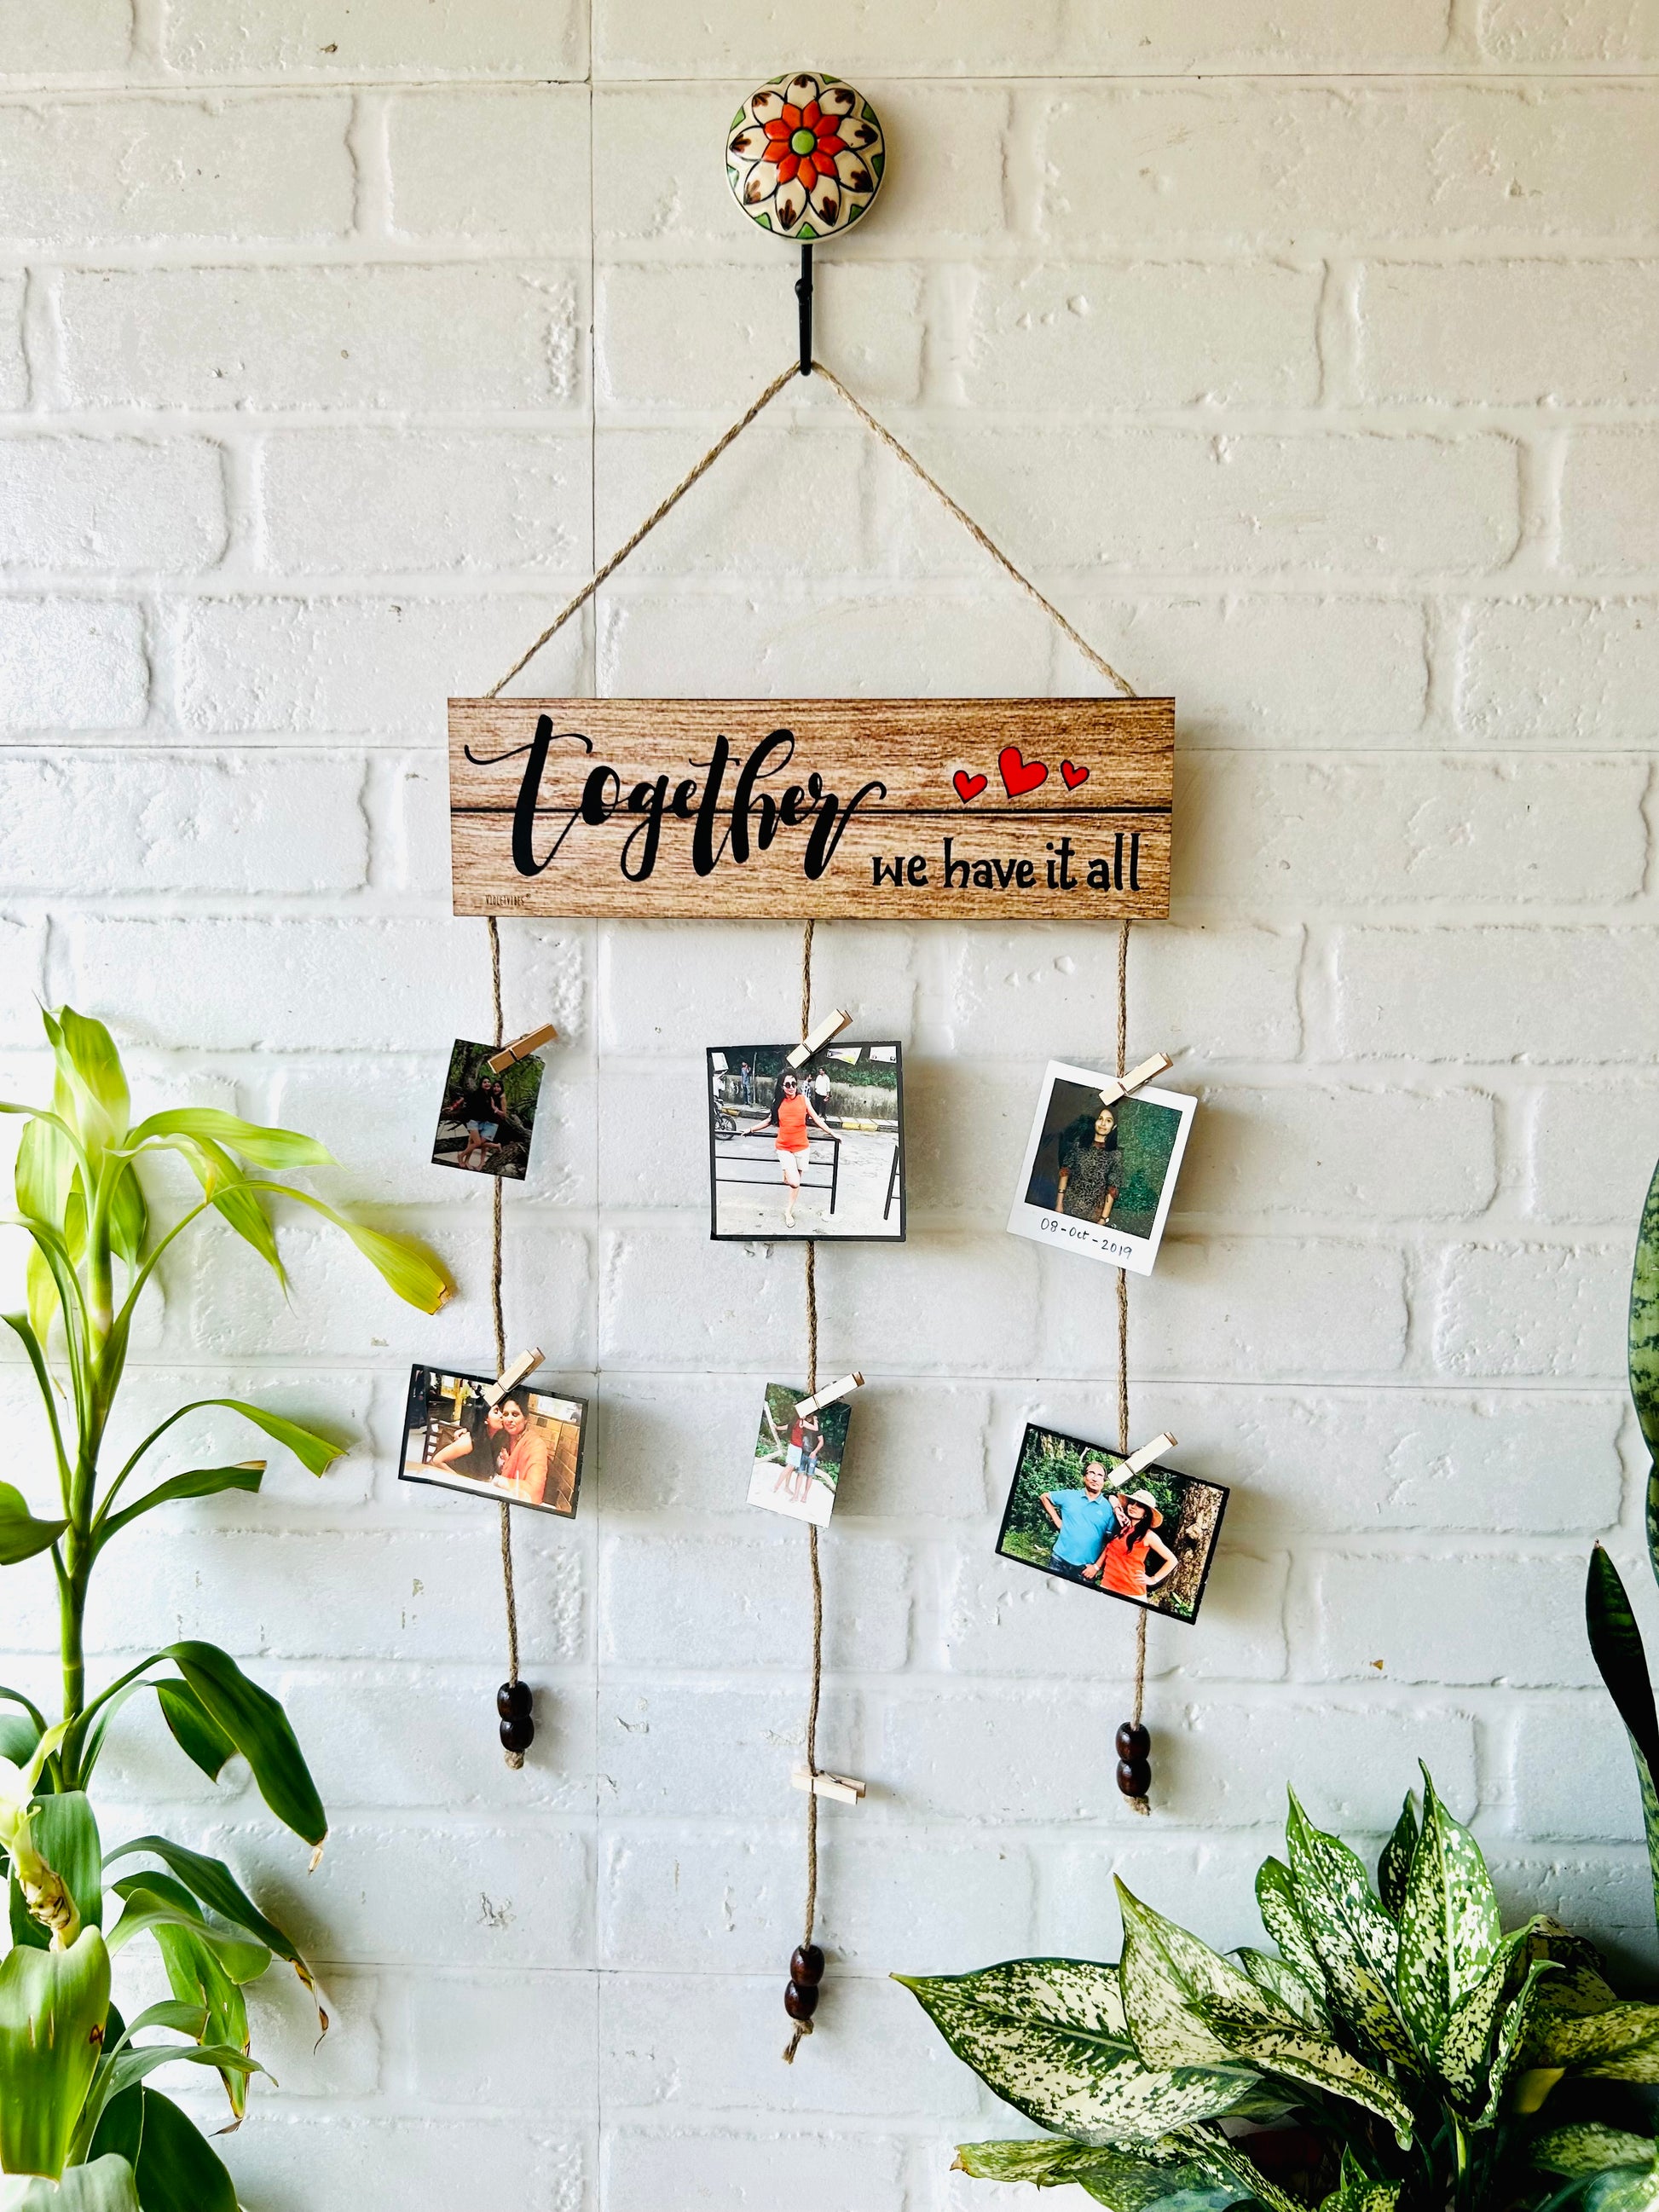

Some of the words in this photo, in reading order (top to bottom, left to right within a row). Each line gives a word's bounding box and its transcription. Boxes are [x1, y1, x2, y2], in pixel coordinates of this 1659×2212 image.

[463, 713, 887, 881] together
[872, 855, 929, 887] we
[943, 836, 1037, 889] have
[1045, 836, 1078, 890] it
[1086, 832, 1142, 892] all
